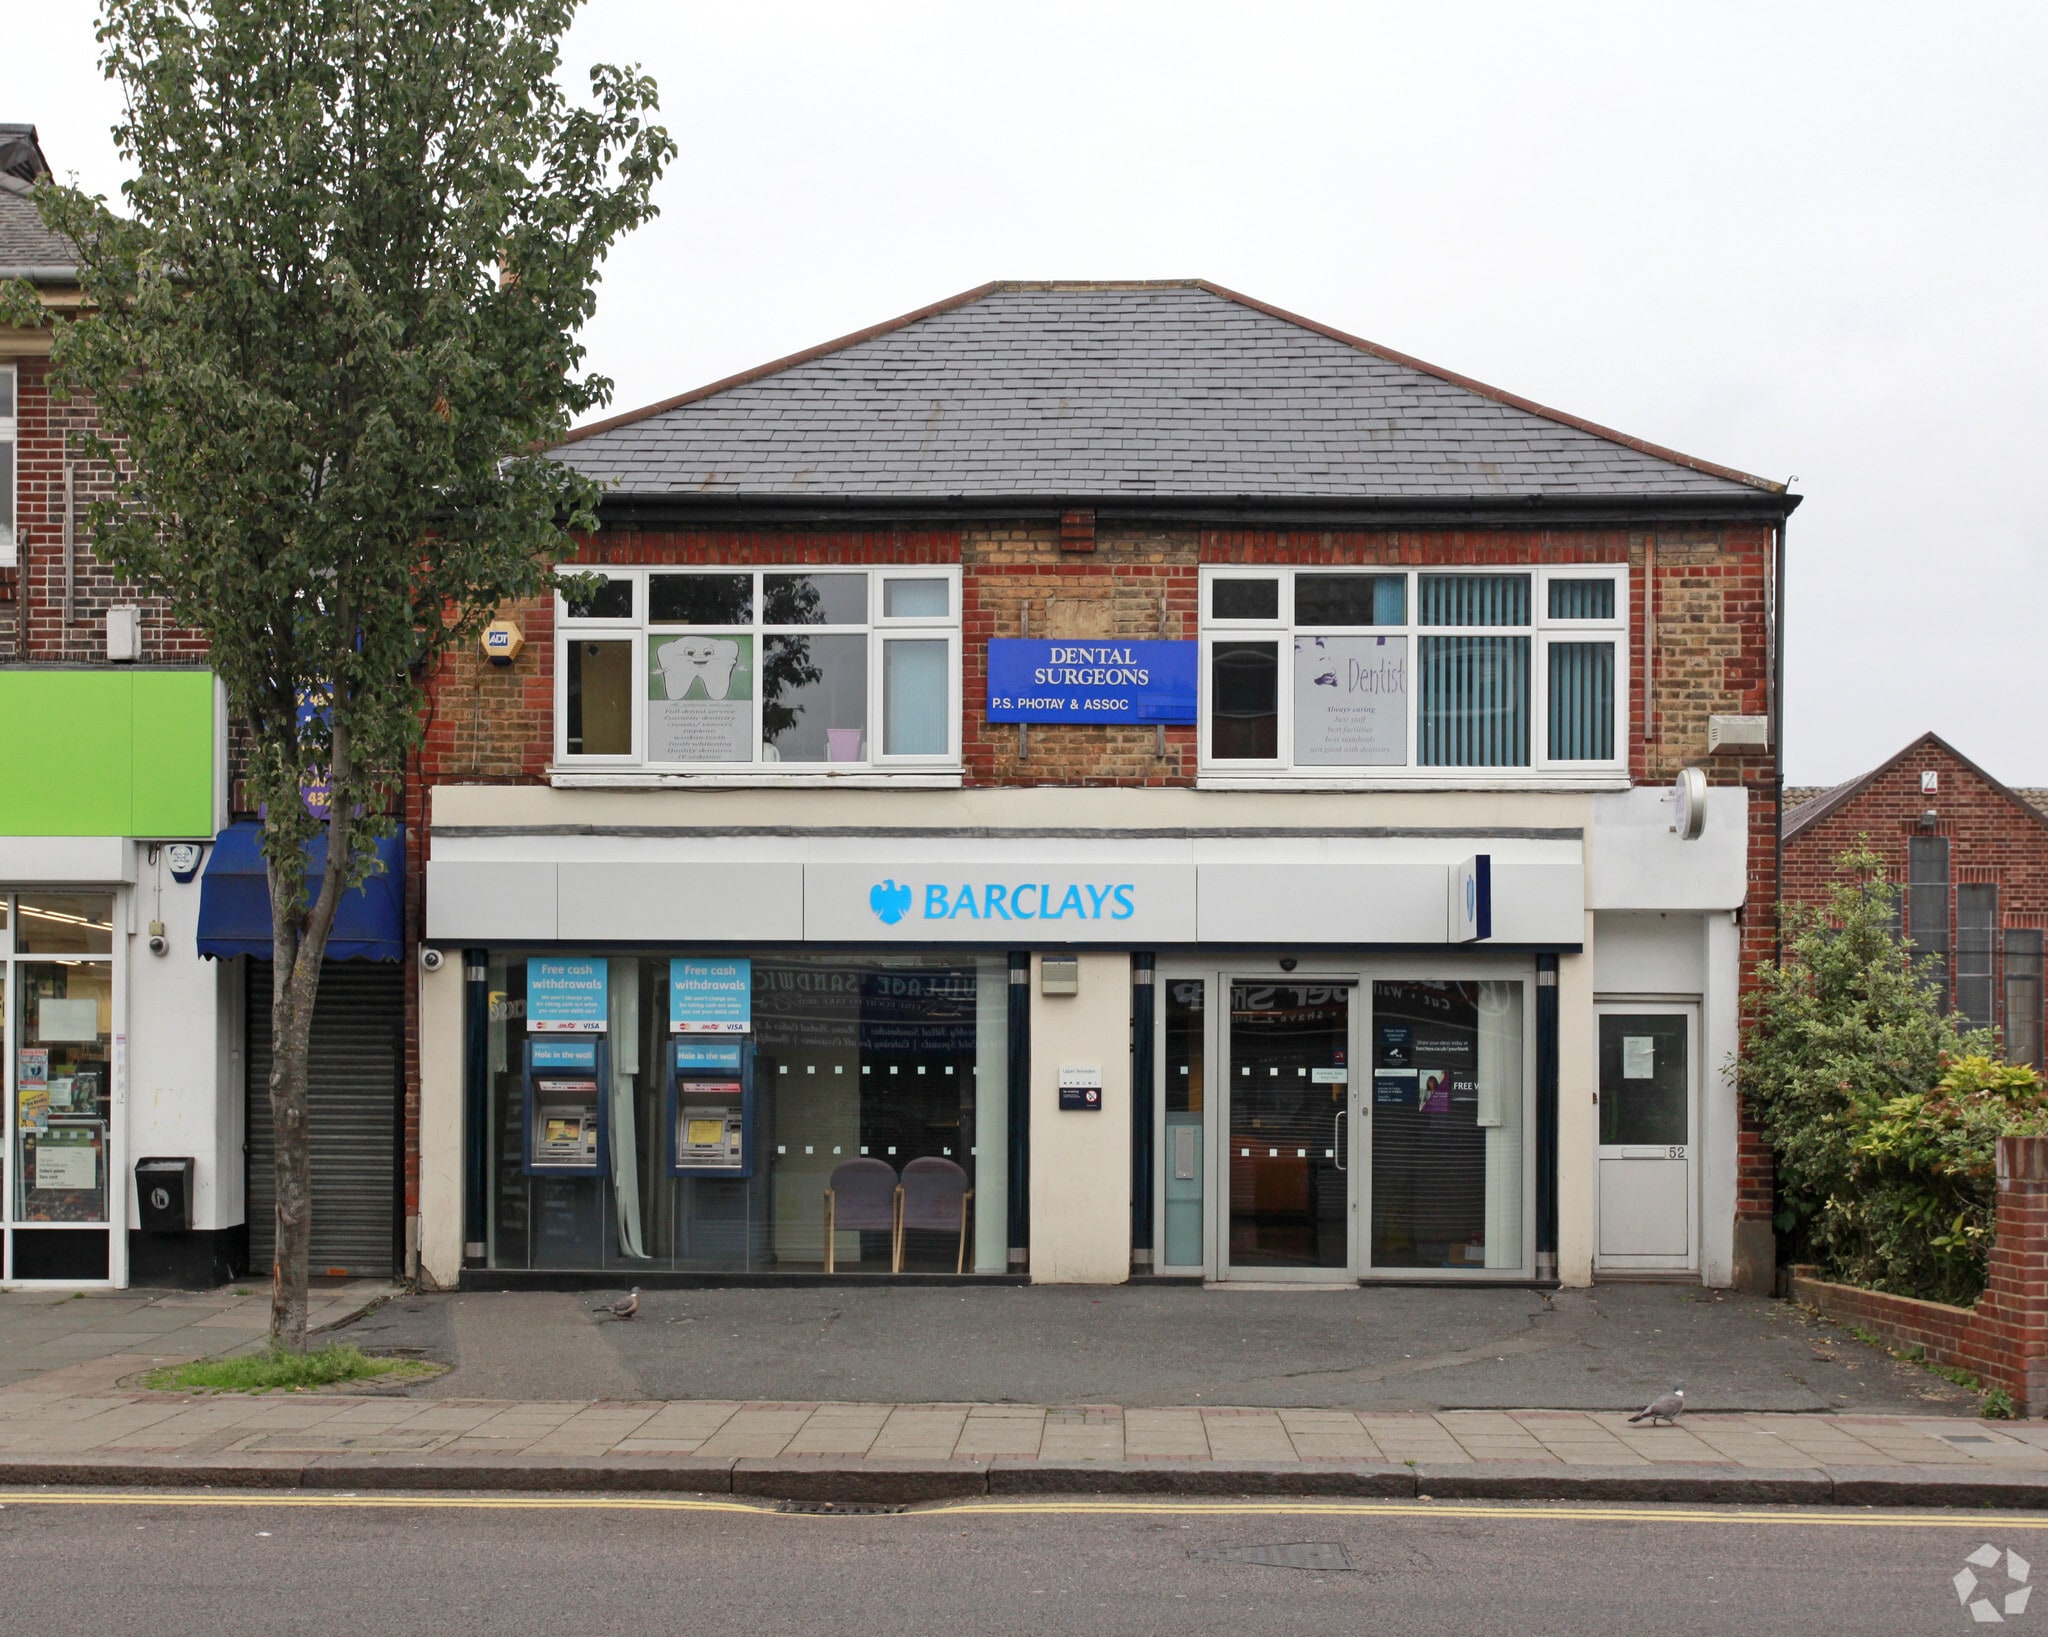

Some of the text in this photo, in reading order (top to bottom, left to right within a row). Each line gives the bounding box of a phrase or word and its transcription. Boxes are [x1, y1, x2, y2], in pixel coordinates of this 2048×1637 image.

[490, 634, 508, 643] ADT
[1050, 648, 1137, 665] DENTAL
[1034, 668, 1149, 686] SURGEONS
[1348, 658, 1405, 694] Dentist
[992, 698, 1128, 710] P.S. PHOTAY & ASSOC
[1327, 705, 1376, 714] Always caring
[923, 883, 1135, 920] BARCLAYS
[541, 964, 592, 974] Free cash
[685, 965, 736, 975] Free cash
[532, 979, 602, 989] withdrawals
[675, 980, 746, 990] withdrawals
[535, 1050, 592, 1059] Hole in the wall
[678, 1051, 737, 1060] Hole in the wall
[1454, 1082, 1472, 1090] FREE
[1669, 1147, 1684, 1158] 52
